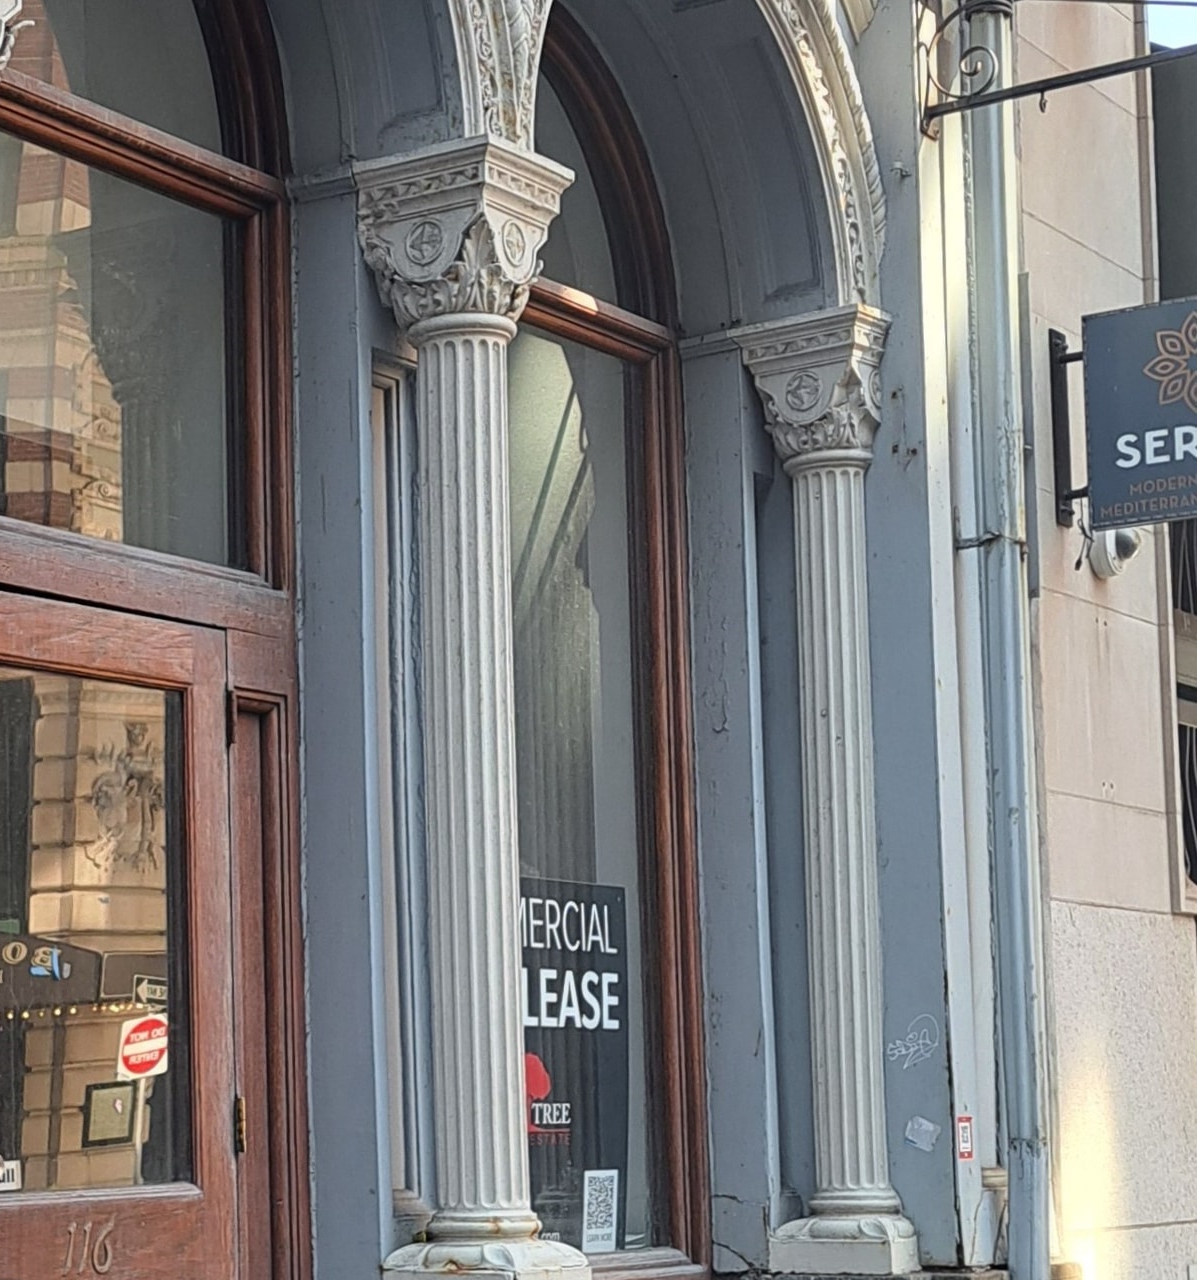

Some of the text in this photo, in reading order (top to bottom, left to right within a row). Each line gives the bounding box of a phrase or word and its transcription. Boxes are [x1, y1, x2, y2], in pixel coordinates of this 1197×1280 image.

[522, 966, 620, 1031] LEASE
[530, 1102, 572, 1125] TREE
[63, 1216, 116, 1276] 116
